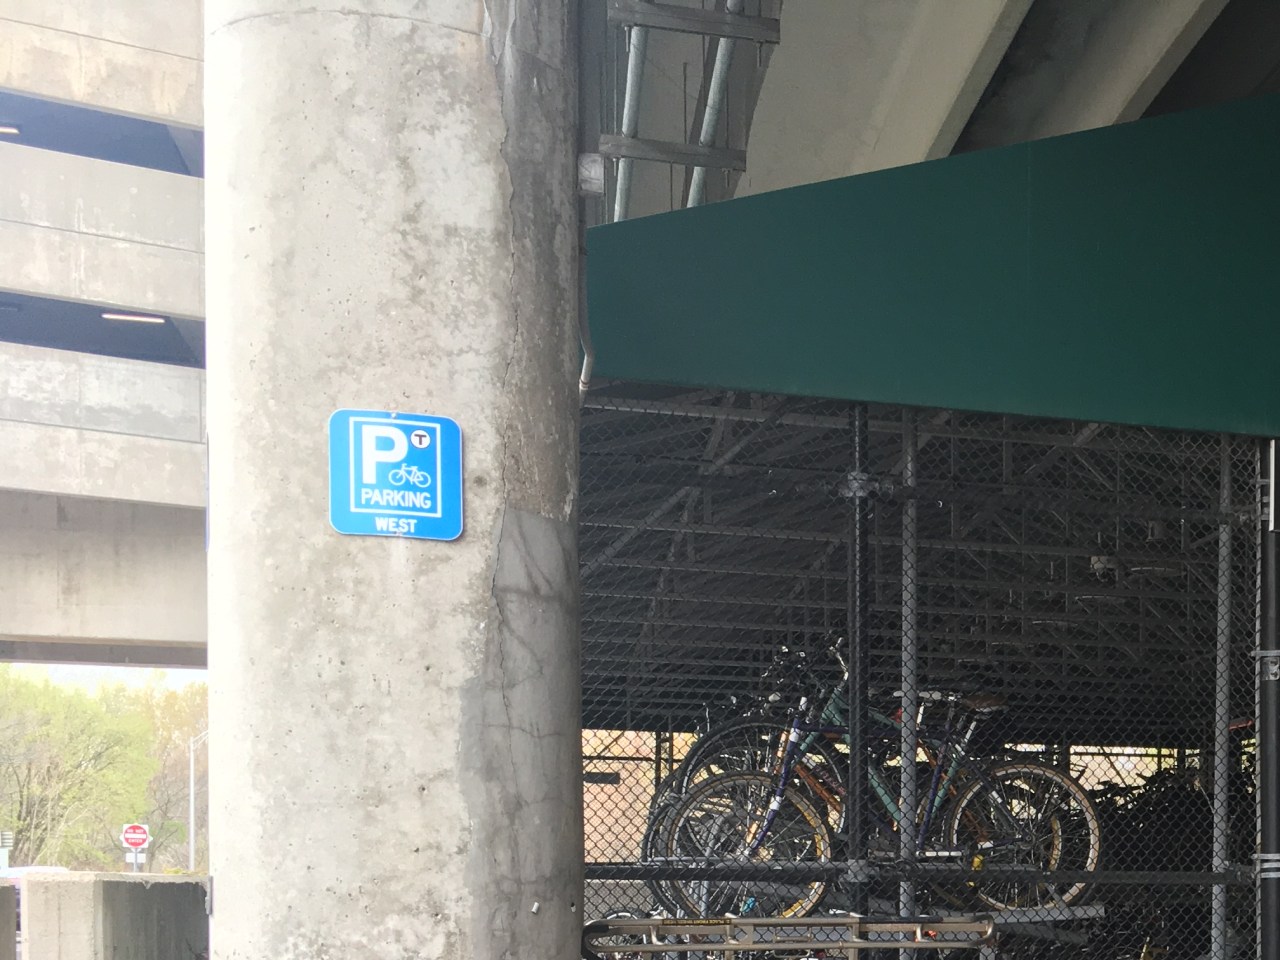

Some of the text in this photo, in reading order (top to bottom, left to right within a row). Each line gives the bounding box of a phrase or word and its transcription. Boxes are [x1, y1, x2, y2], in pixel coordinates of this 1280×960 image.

[414, 434, 426, 445] T
[362, 425, 408, 484] P
[361, 488, 431, 509] PARKING
[375, 517, 417, 533] WEST
